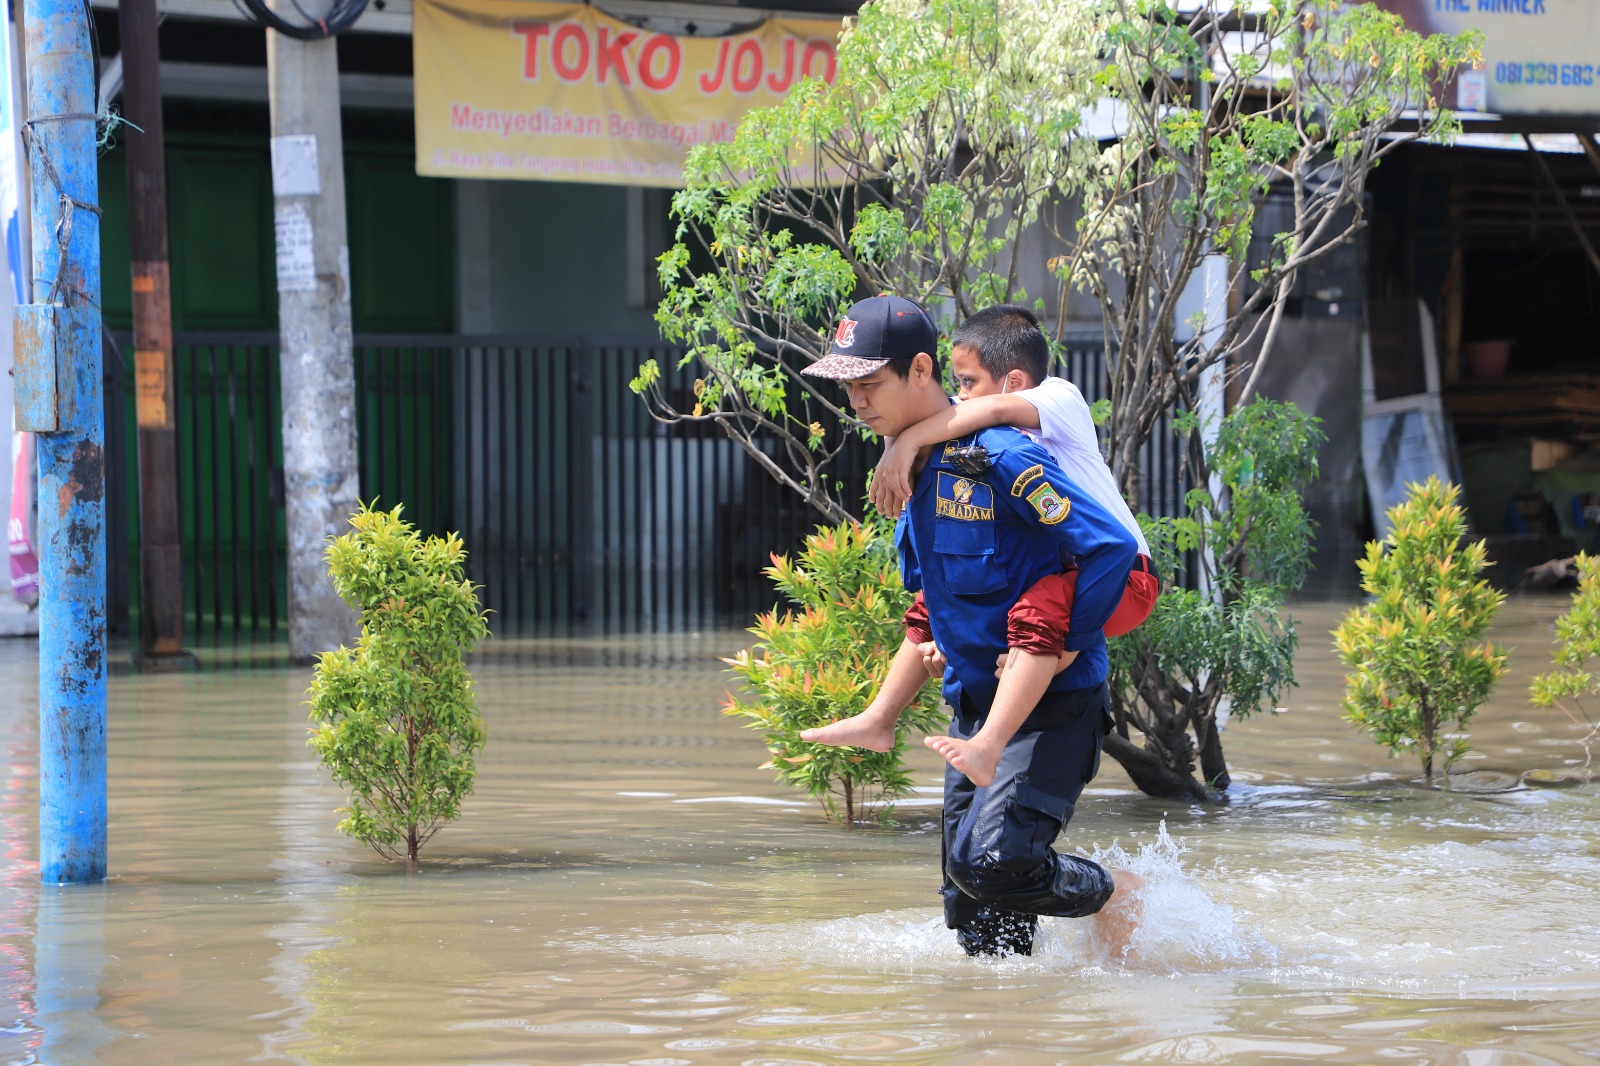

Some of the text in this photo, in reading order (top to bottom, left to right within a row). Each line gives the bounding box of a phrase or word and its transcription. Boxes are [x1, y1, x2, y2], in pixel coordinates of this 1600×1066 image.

[513, 21, 837, 94] TOKO JOJO
[450, 103, 602, 138] Menyediakan
[607, 112, 706, 146] Berbagai
[937, 499, 992, 520] PEMADAM
